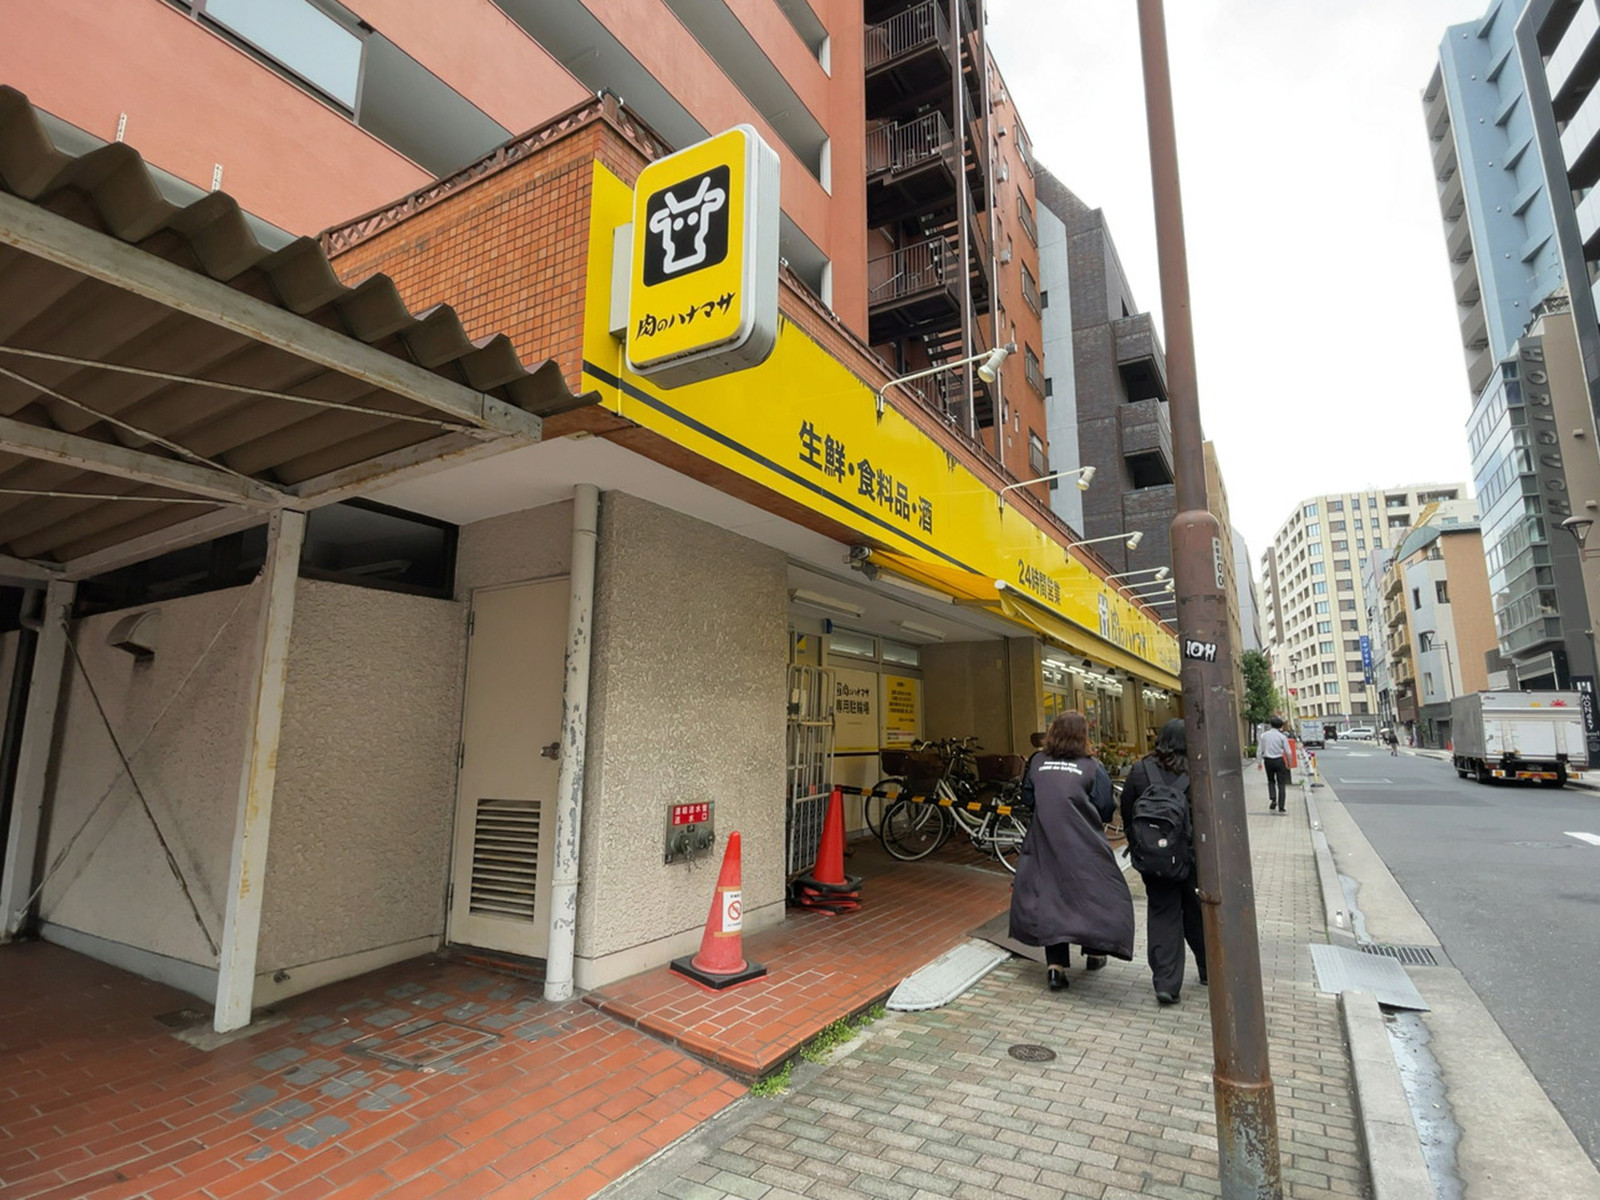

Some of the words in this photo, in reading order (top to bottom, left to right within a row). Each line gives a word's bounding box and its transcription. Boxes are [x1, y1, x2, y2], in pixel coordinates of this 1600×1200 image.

[636, 292, 736, 340] 肉のハナマサ
[798, 419, 933, 535] 生鮮・食料品・酒
[1017, 558, 1061, 606] 24時間営業
